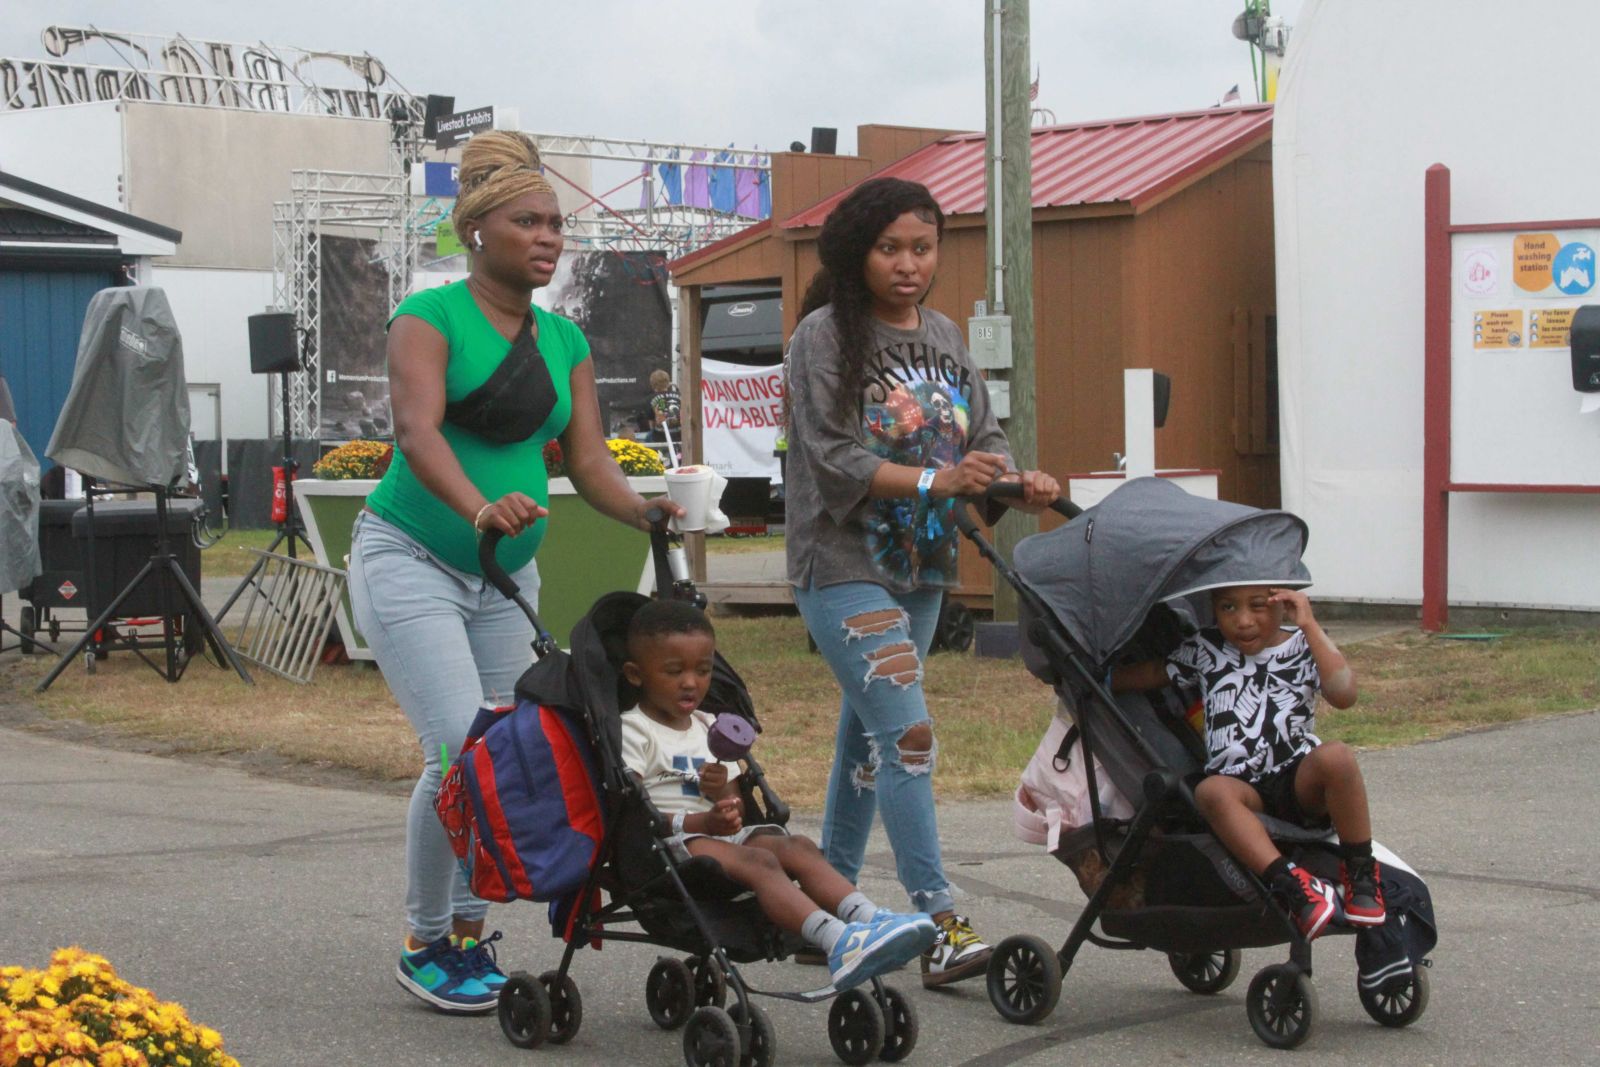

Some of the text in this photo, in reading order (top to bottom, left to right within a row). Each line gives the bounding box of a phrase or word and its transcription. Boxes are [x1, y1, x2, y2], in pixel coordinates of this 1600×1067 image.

[437, 111, 492, 133] Livestock Exhibits
[1523, 241, 1546, 250] Hand
[1517, 252, 1552, 262] washing
[1520, 263, 1549, 272] station
[1233, 677, 1261, 727] NIKE
[1221, 857, 1247, 889] AERO
